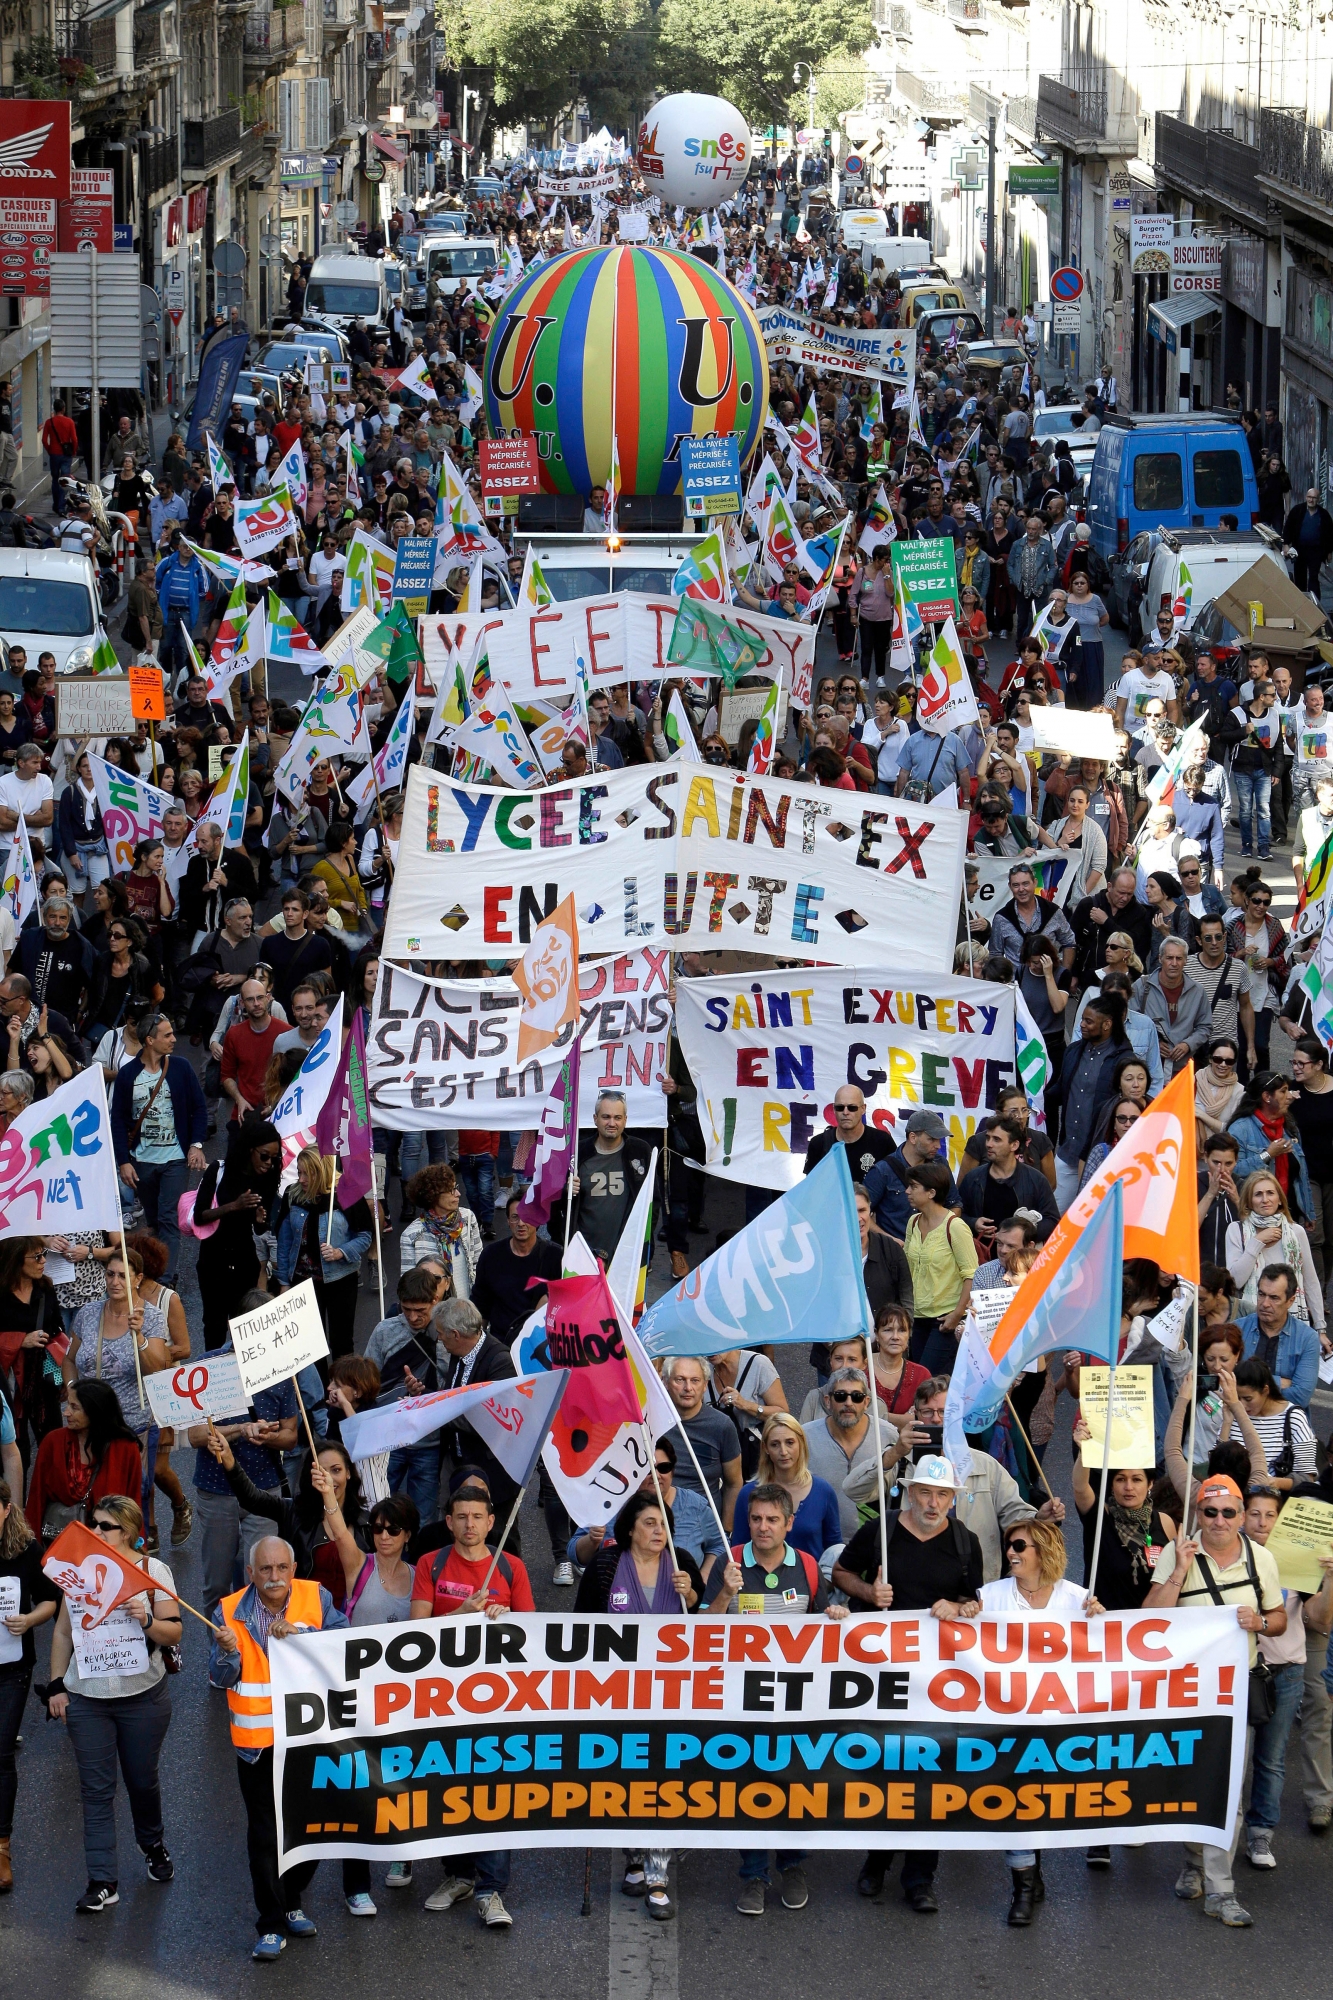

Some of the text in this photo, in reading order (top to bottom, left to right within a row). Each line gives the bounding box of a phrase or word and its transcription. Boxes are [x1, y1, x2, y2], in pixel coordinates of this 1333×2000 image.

[684, 132, 746, 161] snes
[0, 167, 57, 179] ONDA
[694, 163, 713, 175] fsu
[72, 182, 101, 193] MOTO
[1, 199, 52, 211] CASQUES
[4, 211, 48, 222] CORNER
[1173, 245, 1221, 264] BISCUITERIE
[172, 271, 181, 285] P
[1173, 277, 1221, 291] CORSE
[760, 312, 882, 355] TIONAL UNITAIRE
[676, 315, 754, 408] U.
[801, 350, 867, 373] RHONE
[210, 358, 230, 418] MICHELIN
[488, 439, 529, 450] MAL PAYÉ-E
[706, 438, 730, 448] PAYÉ-E
[490, 449, 528, 460] MÉPRISÉ-E
[691, 449, 728, 460] MÉPRISÉ-E
[487, 460, 532, 471] PRÉCARISÉ-E
[688, 459, 733, 470] PRÉCARISÉ-E
[485, 475, 538, 489] ASSEZ !
[686, 474, 739, 489] ASSEZ !
[404, 538, 432, 548] MAL PAYÉ-E
[900, 538, 945, 551] MAL PAYÉ-E
[404, 549, 430, 559] MÉPRISÉ-E
[903, 550, 943, 561] MÉPRISÉ-E
[400, 560, 430, 570] PRÉCARISÉ-E
[900, 561, 948, 573] PRÉCARISÉ-E
[395, 578, 427, 589] ASSEZ
[908, 577, 955, 592] SSEZ !
[60, 683, 120, 699] EMPLOIS
[728, 695, 768, 706] SUPPRESSIO
[96, 713, 128, 729] DUBY
[425, 771, 936, 880] LYCEE SAINT EX
[482, 870, 826, 945] EN LUTTE
[35, 951, 48, 999] ARSEILLE
[704, 982, 999, 1036] SAINT EXUPERY
[374, 1016, 509, 1067] SANS
[736, 1044, 816, 1091] EN
[368, 1041, 666, 1110] C'EST LA IN!
[590, 1170, 625, 1197] 25
[233, 1293, 308, 1341] TITULARISATION
[241, 1320, 300, 1365] DES AAD
[345, 1618, 1174, 1682] POUR UN SERVICE PUBLIC
[103, 1658, 139, 1670] Salaires
[284, 1662, 1236, 1738] DE PROXIMITÉ ET DE QUALITÉ !
[311, 1729, 1203, 1790] NI BAISSE DE POUVOIR D'ACHAT
[375, 1789, 429, 1835] NI
[442, 1780, 829, 1826] SUPPRESSION
[843, 1781, 915, 1820] DE
[930, 1779, 1133, 1821] POSTES
